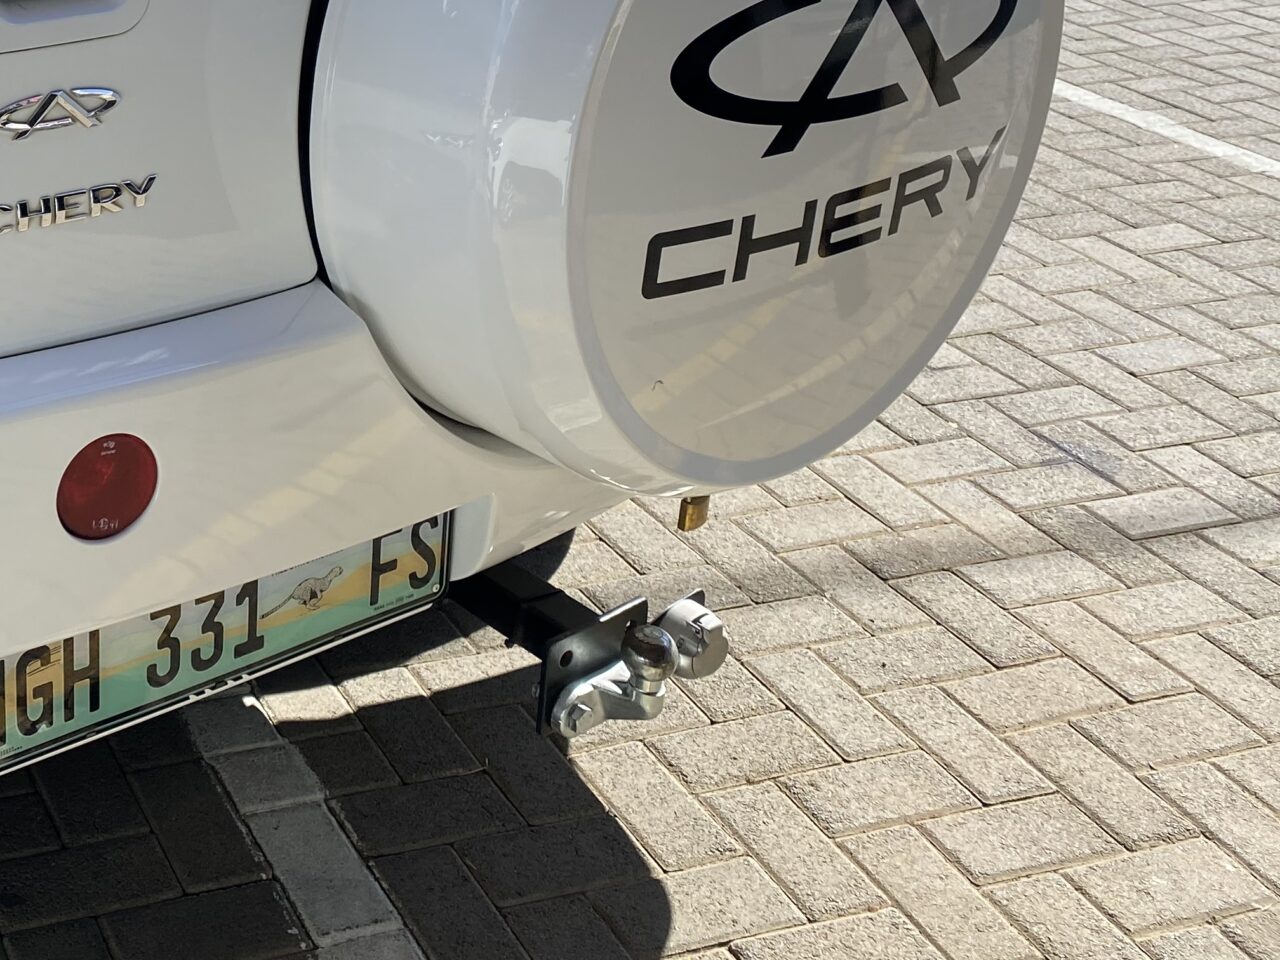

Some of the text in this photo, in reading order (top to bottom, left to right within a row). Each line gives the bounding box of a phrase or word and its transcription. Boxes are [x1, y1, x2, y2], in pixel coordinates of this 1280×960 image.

[641, 124, 1007, 300] CHERY
[146, 579, 265, 689] 331
[370, 515, 439, 606] FS
